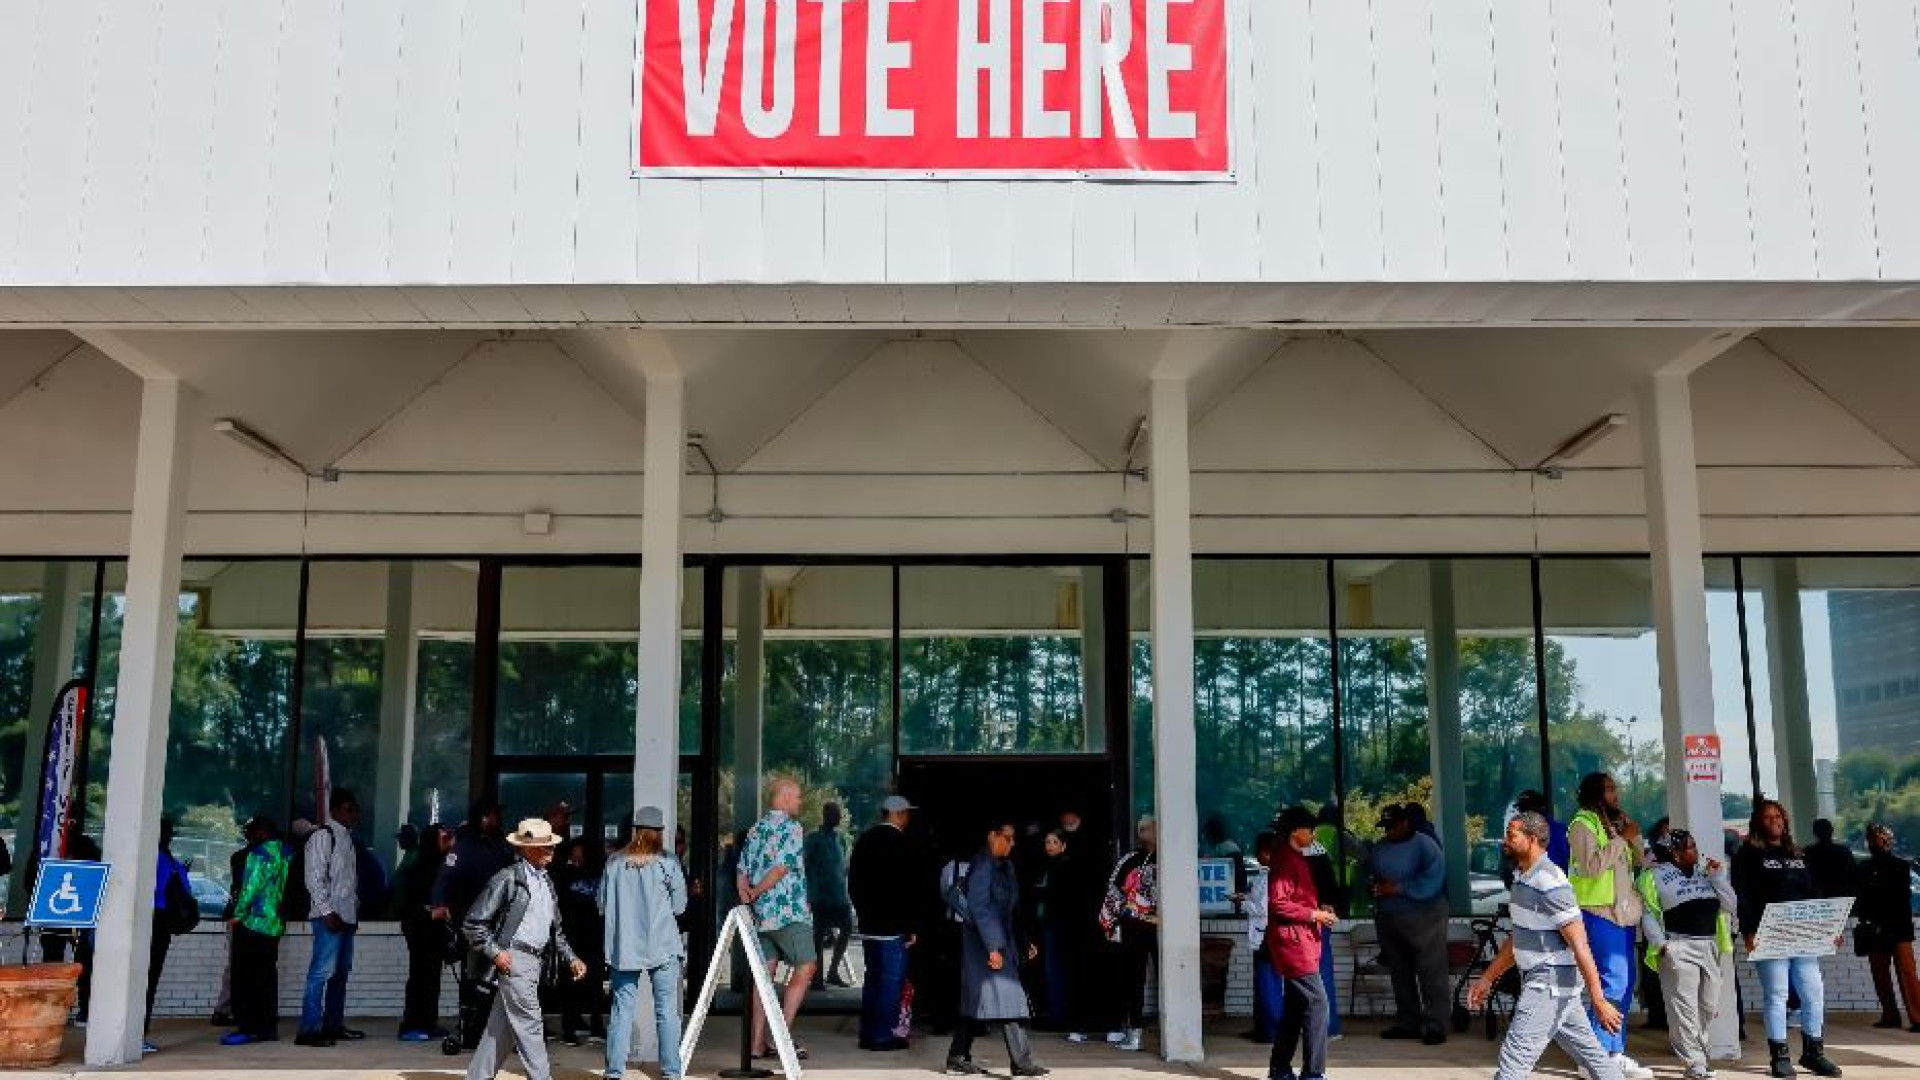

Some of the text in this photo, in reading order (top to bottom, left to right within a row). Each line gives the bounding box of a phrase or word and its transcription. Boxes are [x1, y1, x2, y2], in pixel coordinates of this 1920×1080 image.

[679, 0, 1196, 139] VOTE HERE
[1198, 865, 1226, 881] TE
[1199, 886, 1226, 902] RE
